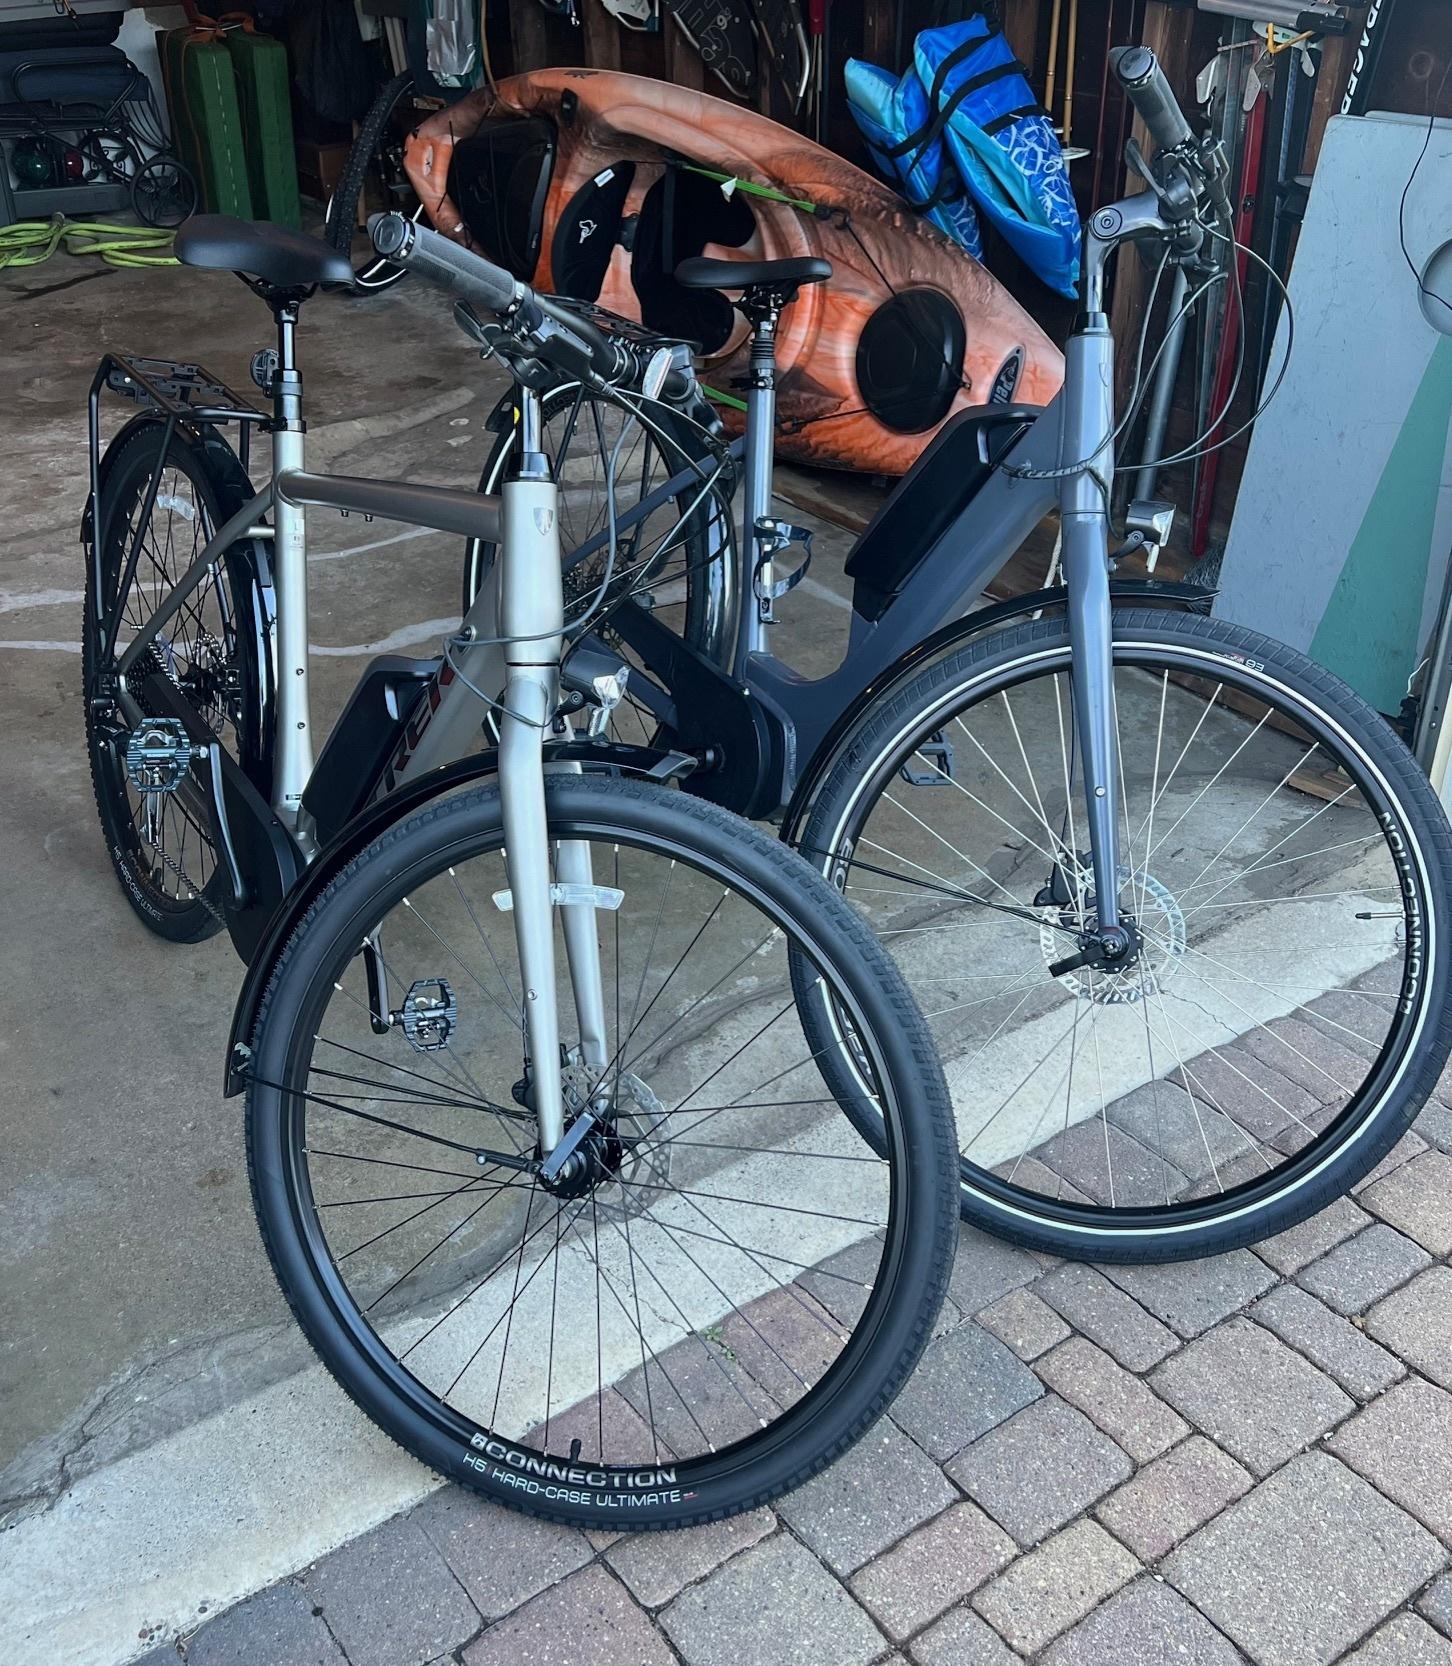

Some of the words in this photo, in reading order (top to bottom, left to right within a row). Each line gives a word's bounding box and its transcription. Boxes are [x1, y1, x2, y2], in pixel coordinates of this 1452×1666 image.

[1378, 811, 1422, 998] CONNECTION
[462, 1452, 488, 1472] H5
[491, 1465, 591, 1506] HARD-CASE
[596, 1489, 681, 1508] ULTIMATE
[485, 1440, 677, 1488] CONNECTION
